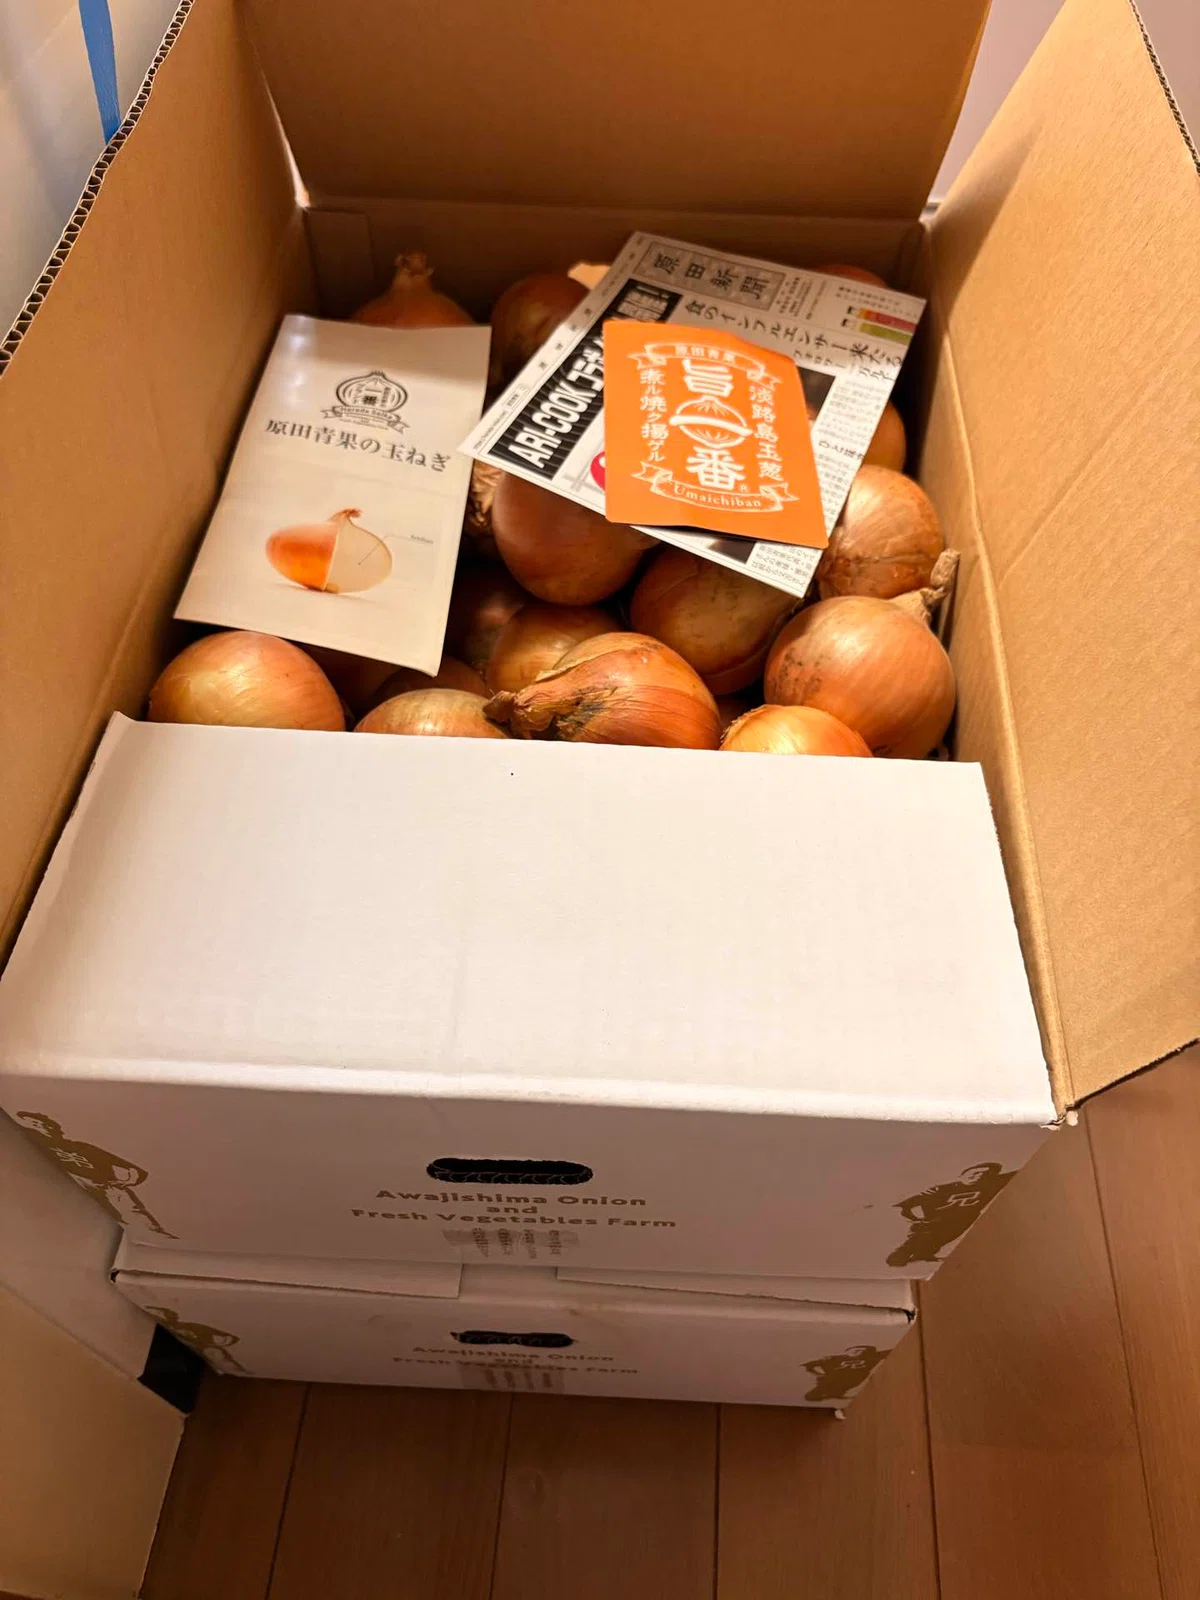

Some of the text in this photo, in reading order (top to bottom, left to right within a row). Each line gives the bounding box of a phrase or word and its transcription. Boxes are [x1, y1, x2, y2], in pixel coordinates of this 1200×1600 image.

[653, 252, 771, 300] 原田新聞
[266, 419, 451, 473] 原田青果の玉ねぎ
[673, 483, 761, 508] Umaichiban
[375, 1189, 647, 1206] Awajishima Onion
[351, 1208, 676, 1228] Fresh Vegetables Farm
[486, 1205, 538, 1214] and
